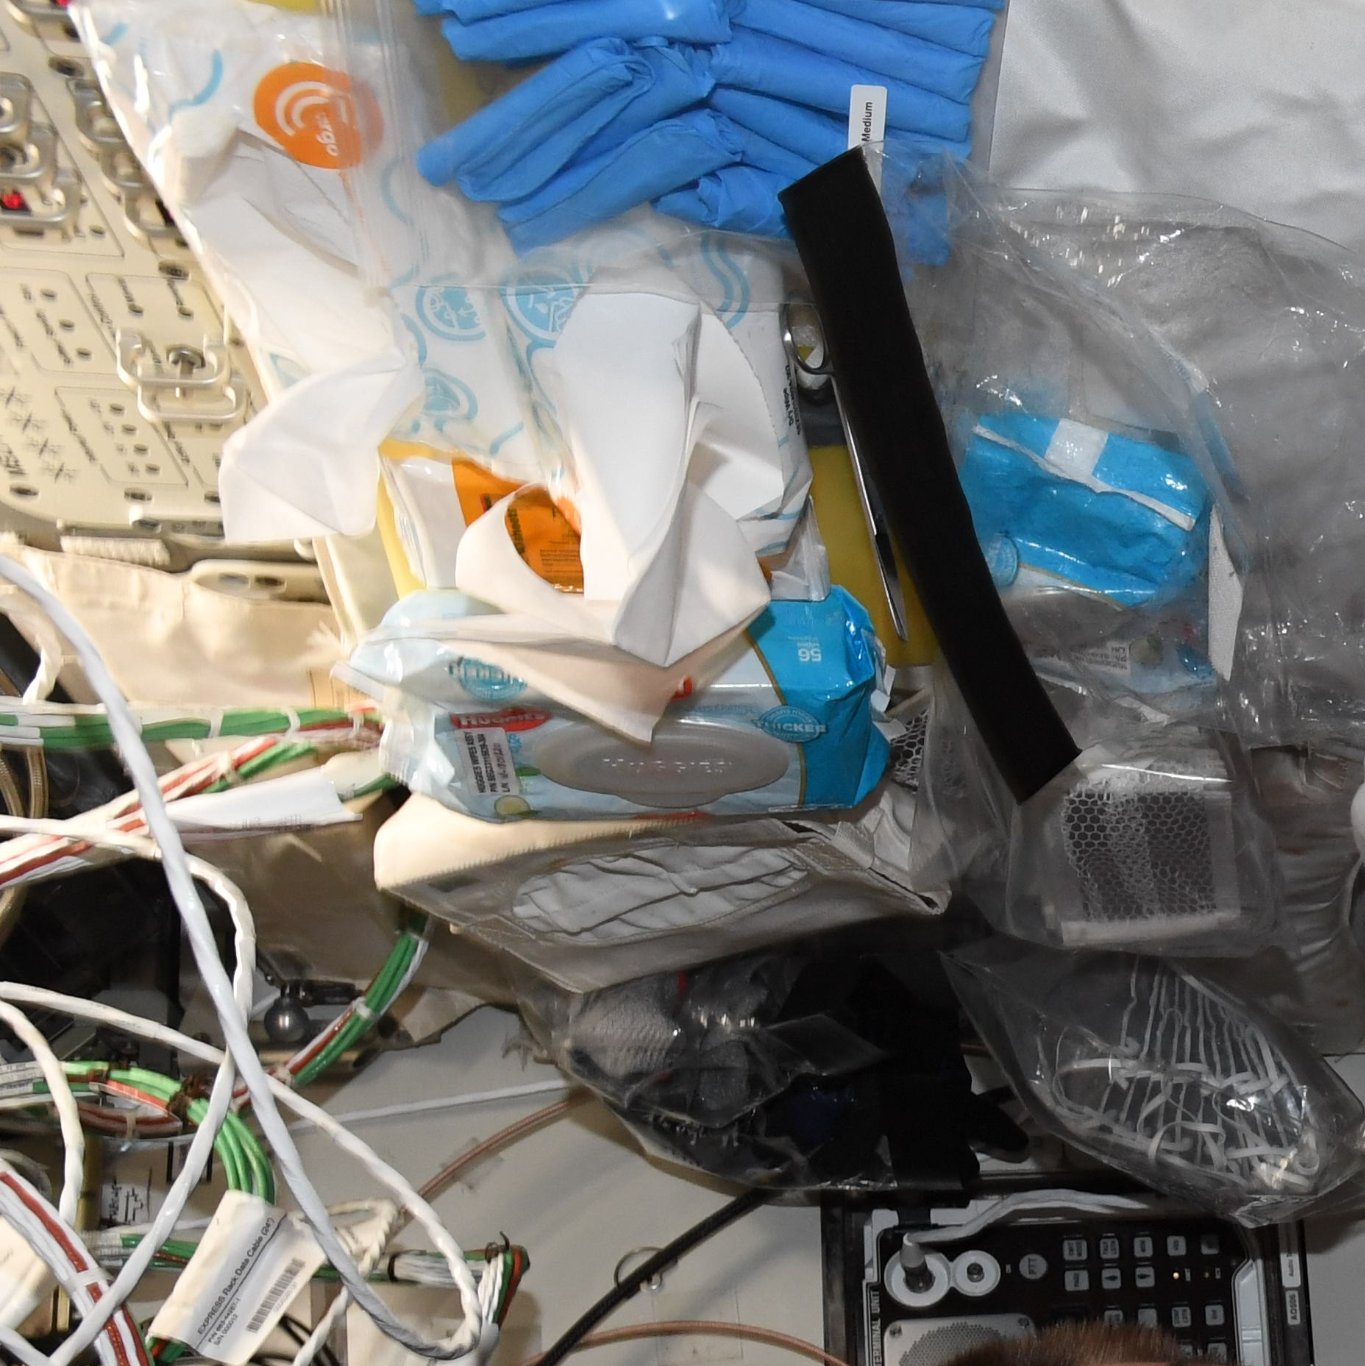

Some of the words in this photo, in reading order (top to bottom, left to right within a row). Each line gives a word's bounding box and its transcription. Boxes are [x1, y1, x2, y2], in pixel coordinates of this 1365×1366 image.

[860, 101, 873, 141] Medium
[797, 648, 821, 661] 56
[463, 731, 474, 745] ASSY
[467, 746, 479, 765] WIPES
[472, 766, 485, 792] HUGGIES
[1028, 1258, 1036, 1274] PTT
[196, 1294, 227, 1335] EXPRESS
[221, 1274, 240, 1296] Rack
[233, 1255, 252, 1277] Data
[245, 1233, 265, 1257] Cable
[870, 1289, 881, 1312] UNIT
[872, 1317, 882, 1366] TERMINAL
